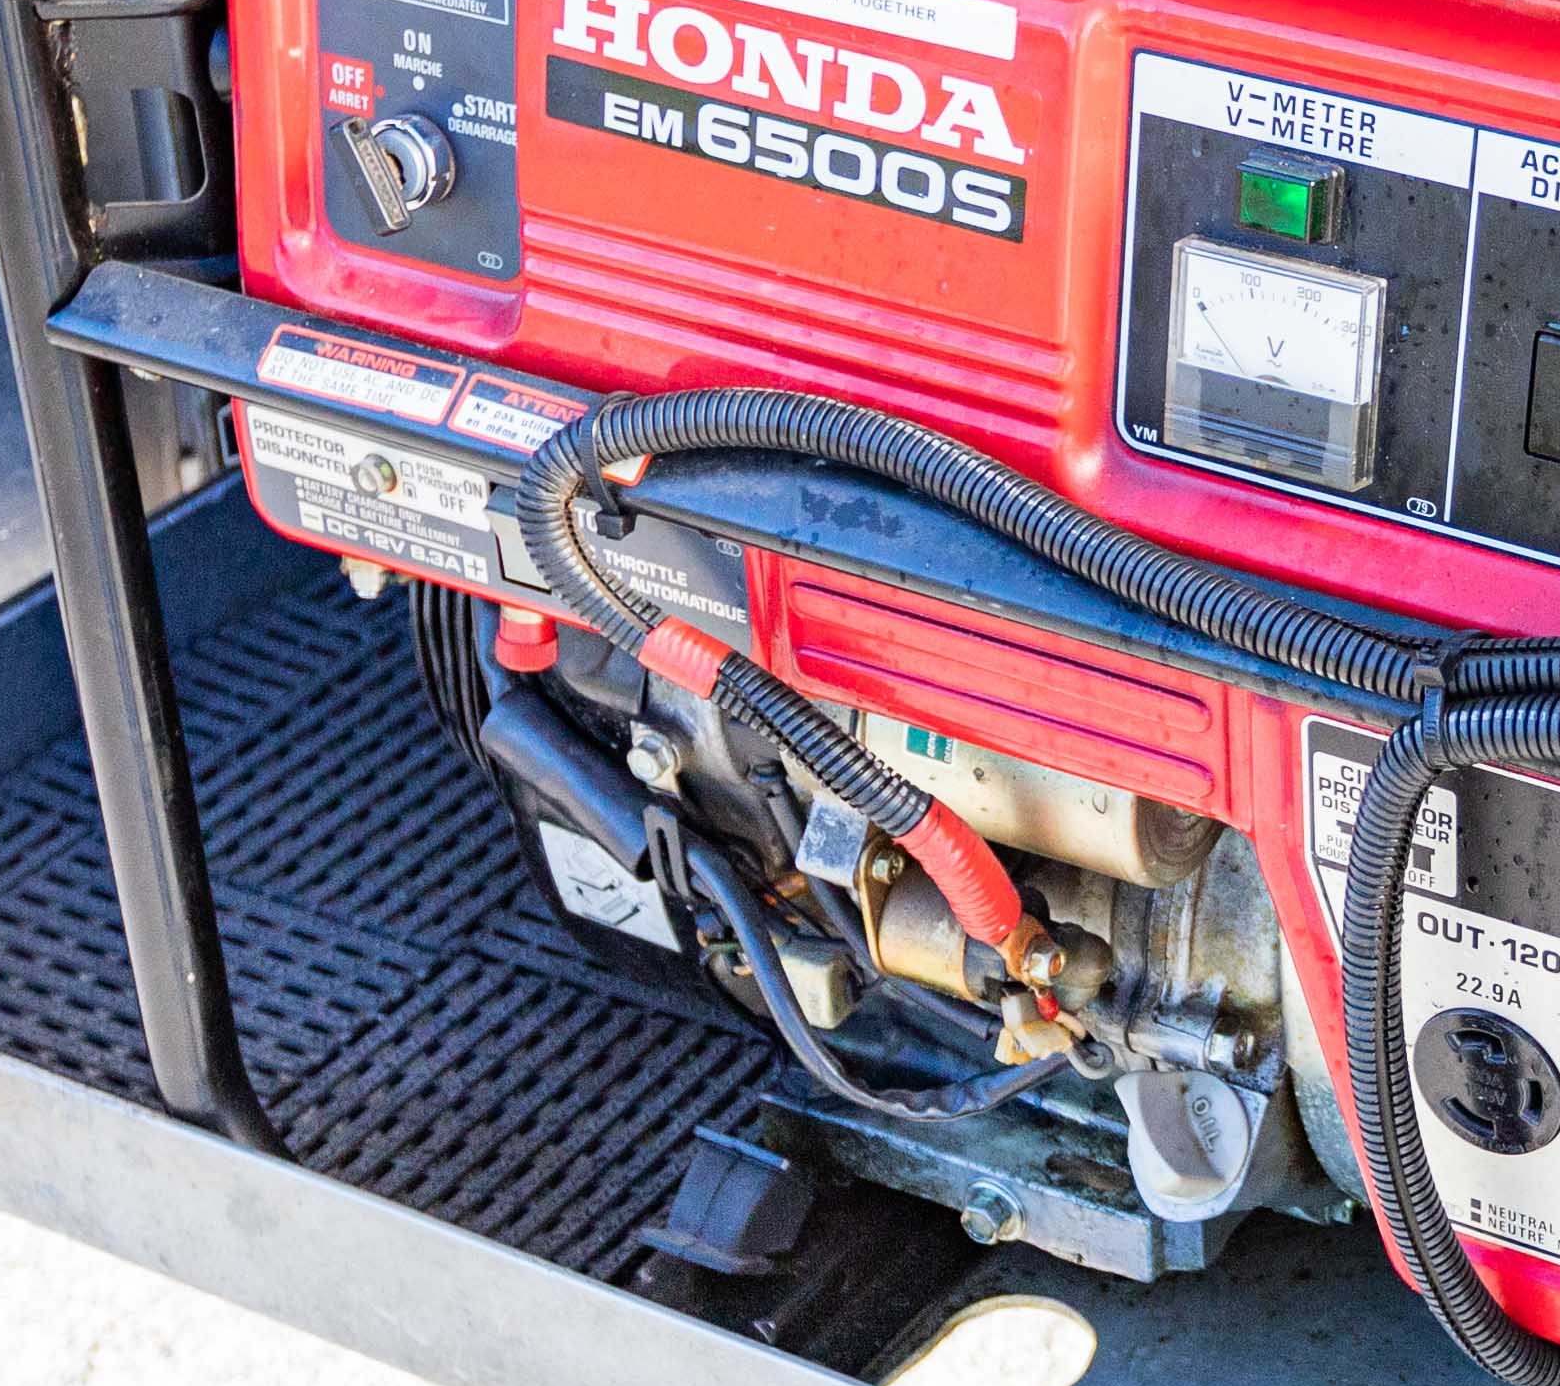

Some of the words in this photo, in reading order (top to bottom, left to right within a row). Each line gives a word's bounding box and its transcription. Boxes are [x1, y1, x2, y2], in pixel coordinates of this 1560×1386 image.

[403, 28, 433, 56] ON
[331, 62, 366, 90] OFF
[393, 53, 444, 78] MARCHE
[328, 88, 370, 112] ARRET
[463, 94, 518, 126] START
[603, 91, 685, 148] EM
[696, 101, 1013, 234] 6500S
[1520, 148, 1560, 176] AC
[1240, 272, 1262, 288] 100
[1297, 286, 1322, 303] 200
[316, 342, 418, 379] WARNING
[1267, 336, 1286, 359] V
[466, 416, 480, 428] en
[473, 401, 489, 414] Ne
[493, 410, 515, 424] pas
[252, 418, 346, 456] PROTECTOR
[1132, 423, 1158, 443] YM
[256, 437, 353, 476] DISJONCTEU
[439, 492, 465, 514] OFF
[463, 479, 484, 499] ON
[326, 516, 359, 541] DC
[364, 529, 406, 556] 12V
[410, 545, 462, 574] 8.3A
[602, 548, 688, 588] THROTTLE
[628, 575, 748, 625] AUTOMATIQUE
[1408, 869, 1437, 889] OFF
[1456, 971, 1523, 1010] 22.9A
[1191, 1095, 1221, 1154] OIL
[1488, 1202, 1556, 1235] NEUTRAL
[1488, 1215, 1546, 1246] NEUTRE
